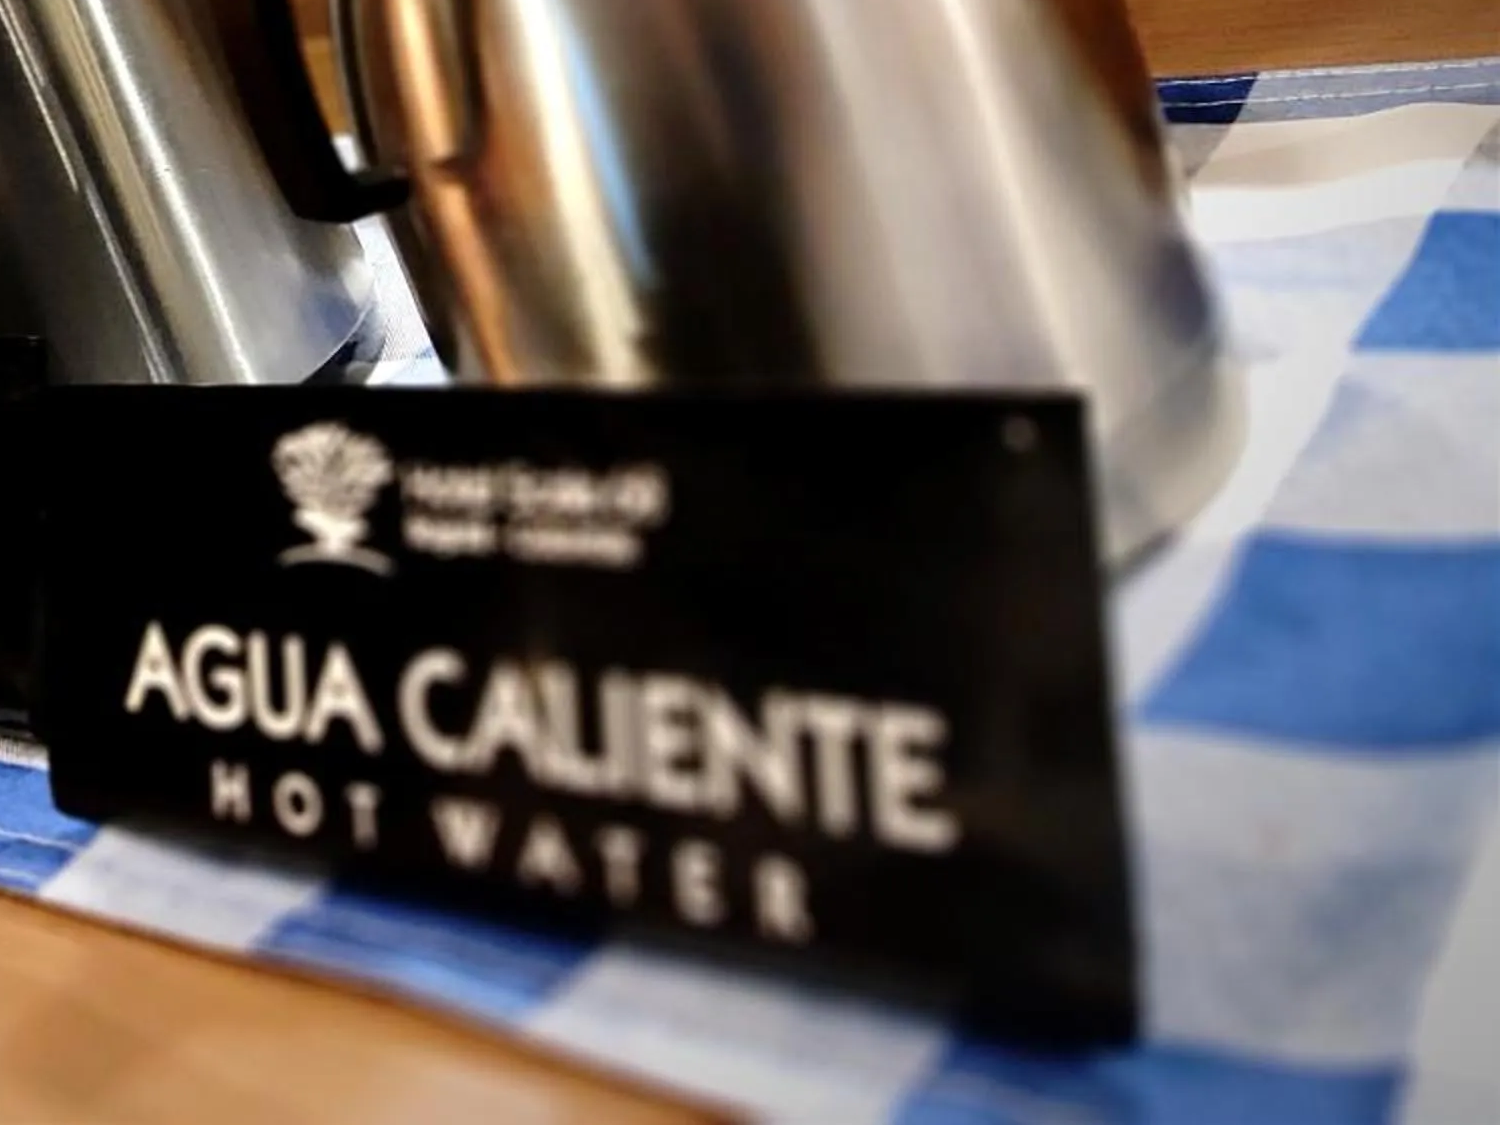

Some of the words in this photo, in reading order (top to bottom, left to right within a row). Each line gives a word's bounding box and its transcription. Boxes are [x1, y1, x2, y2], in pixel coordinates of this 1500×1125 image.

[124, 620, 384, 754] AGUA
[398, 647, 959, 852] CALIENTE
[210, 759, 380, 848] HOT
[431, 793, 813, 941] WATER
